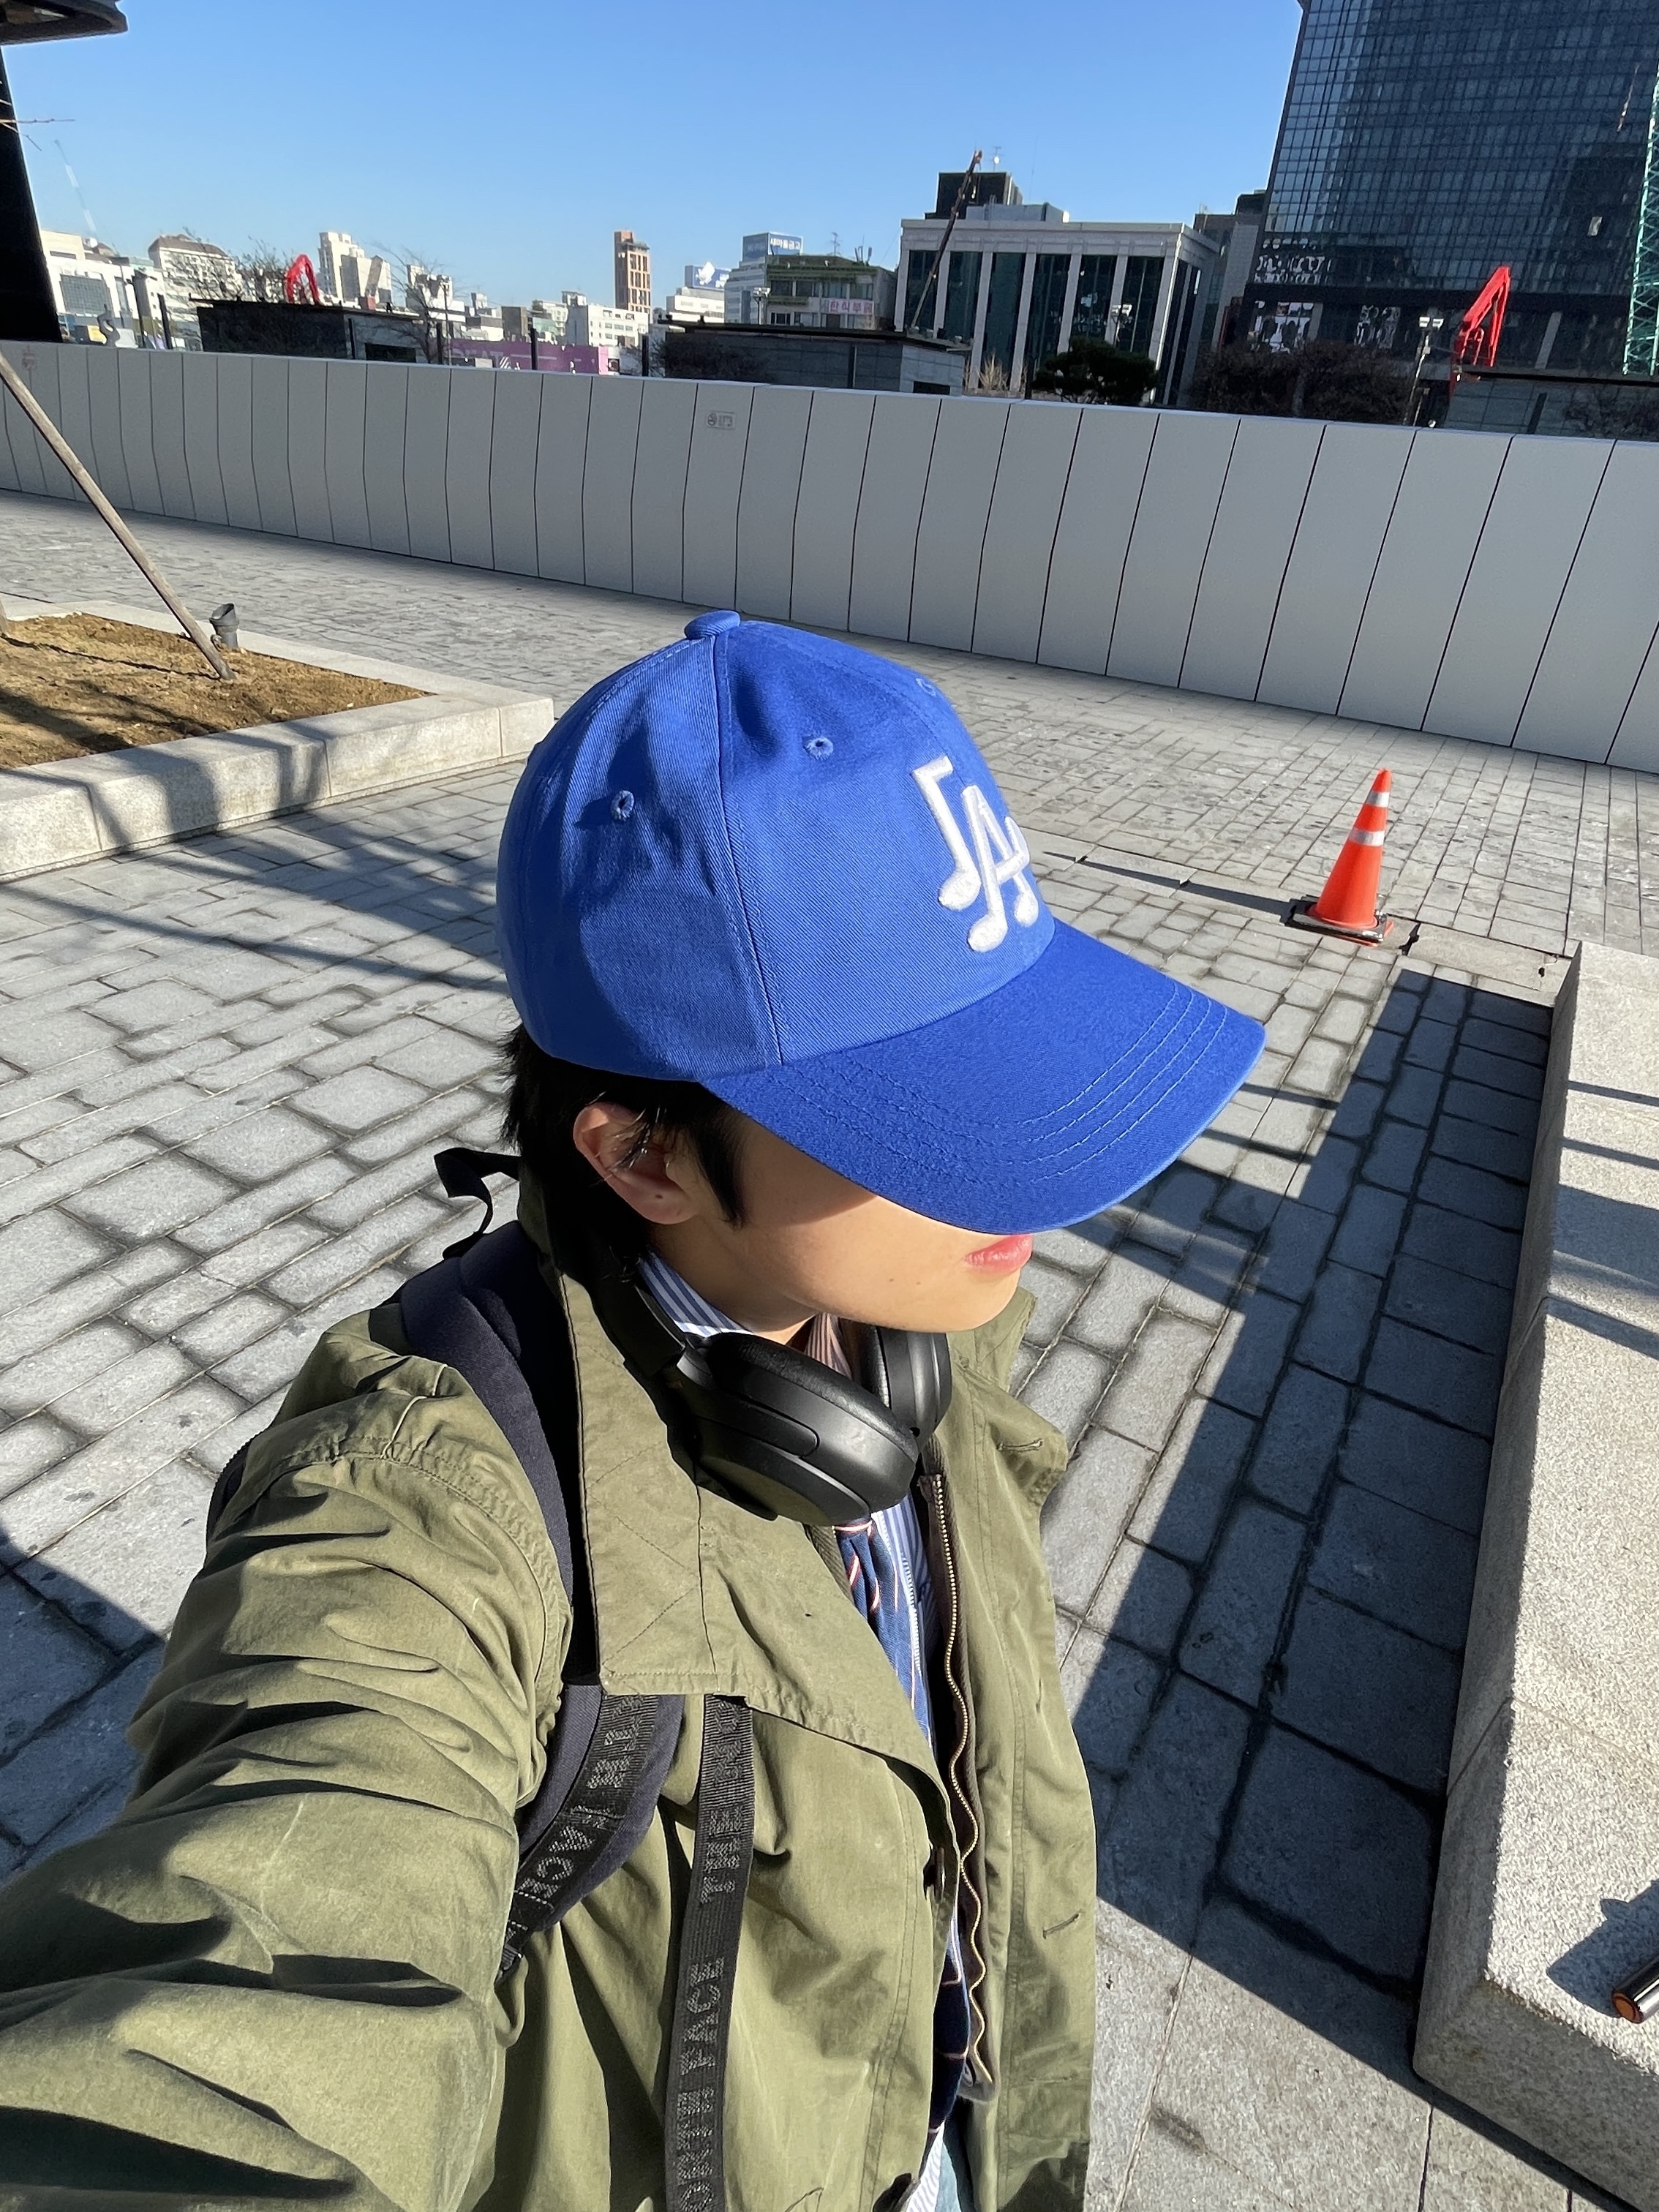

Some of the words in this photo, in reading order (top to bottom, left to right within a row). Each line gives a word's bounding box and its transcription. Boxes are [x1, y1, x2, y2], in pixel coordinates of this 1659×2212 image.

[770, 237, 801, 250] 새마을금고
[700, 1805, 743, 1904] THE
[679, 1957, 725, 2077] FACE
[675, 2087, 715, 2212] ORTH
